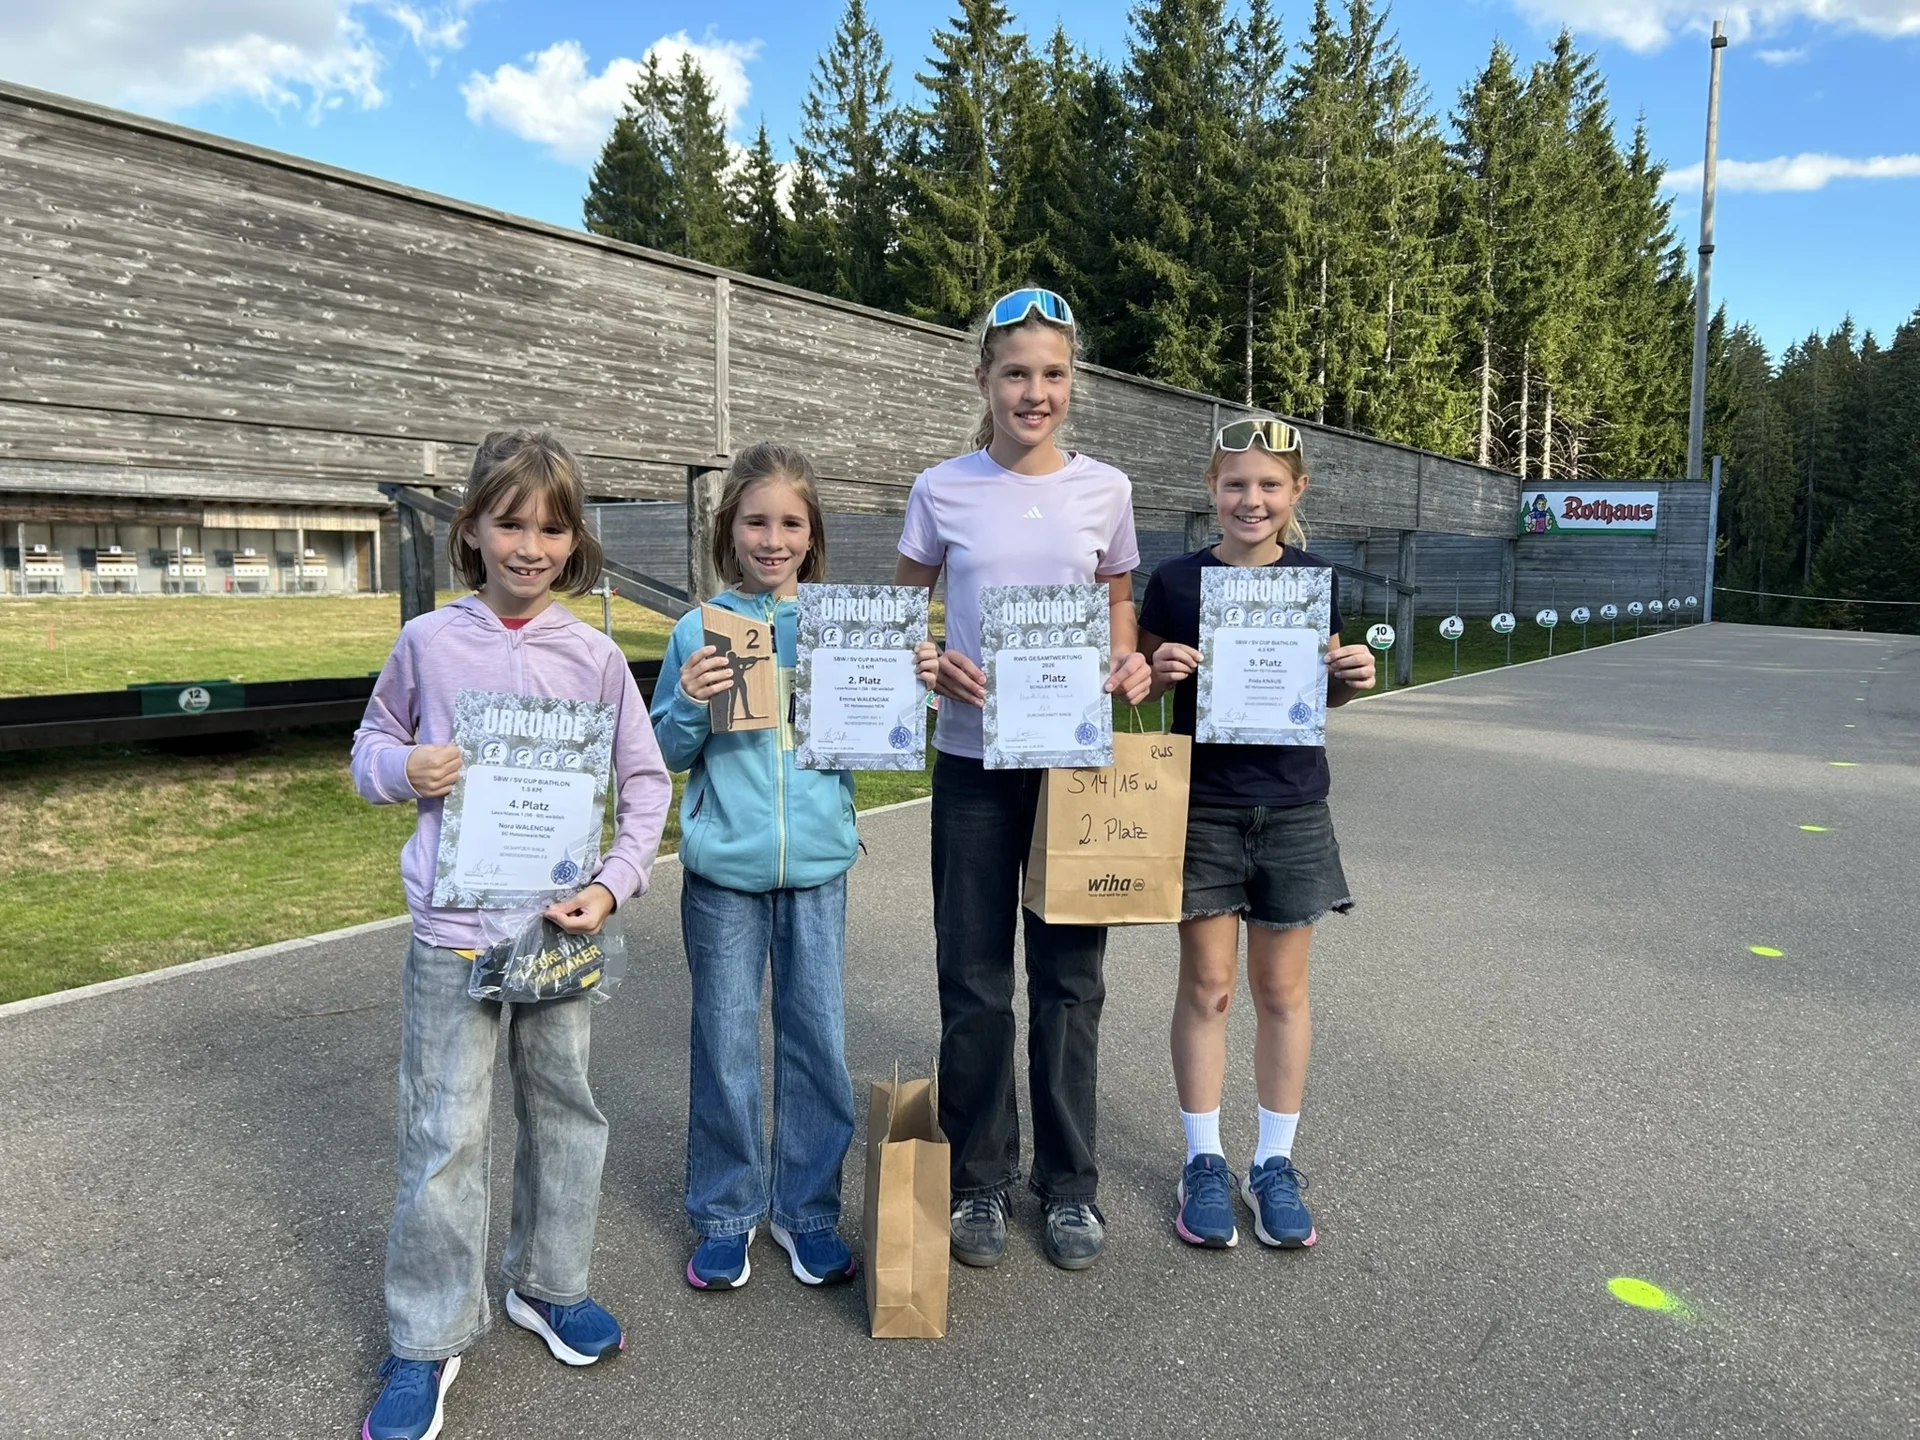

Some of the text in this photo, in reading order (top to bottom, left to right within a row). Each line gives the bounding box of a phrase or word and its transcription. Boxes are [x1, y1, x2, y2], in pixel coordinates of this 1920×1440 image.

[1561, 496, 1654, 525] Rothaus
[1224, 579, 1308, 602] URKUNDE
[821, 598, 906, 622] URKUNDE
[1002, 600, 1086, 625] URKUNDE
[1375, 626, 1387, 636] 10
[1449, 619, 1455, 628] 9
[746, 629, 760, 649] 2
[1249, 658, 1282, 667] 9. Platz
[858, 676, 881, 684] Platz
[1042, 674, 1066, 682] Platz
[188, 689, 201, 699] 12
[484, 708, 586, 743] URKUNDE
[1150, 745, 1174, 760] RWS
[538, 779, 570, 787] BIATHLON
[1067, 769, 1085, 794] S
[1145, 780, 1158, 791] w
[509, 799, 549, 811] 4. Platz
[515, 824, 556, 832] WALENCIAK
[1079, 814, 1148, 845] 2. Platz
[1088, 874, 1131, 892] wiha
